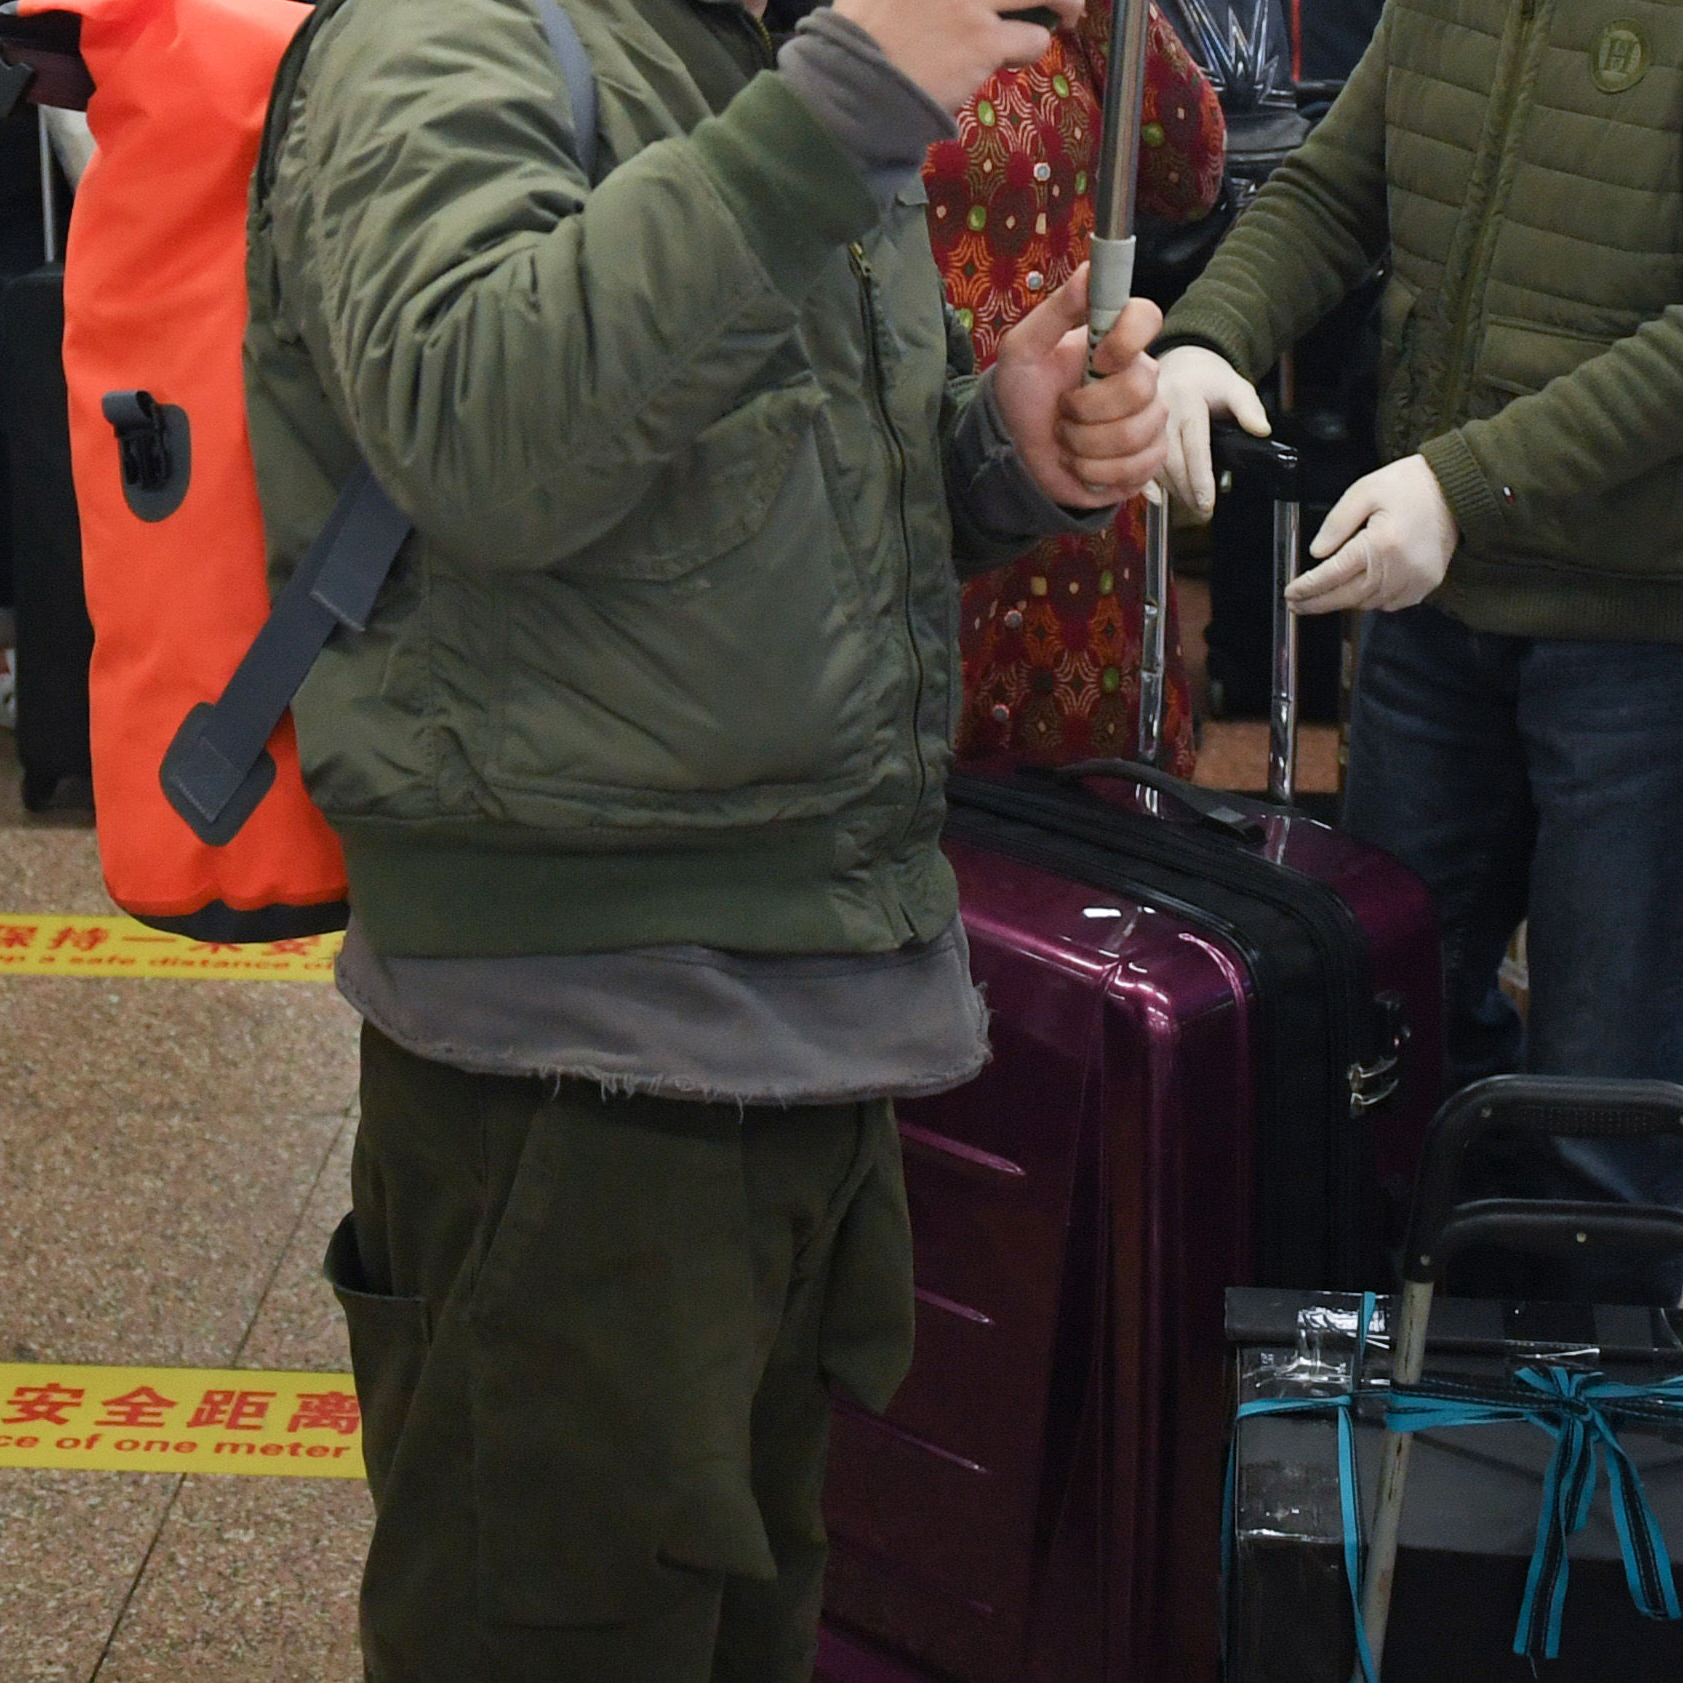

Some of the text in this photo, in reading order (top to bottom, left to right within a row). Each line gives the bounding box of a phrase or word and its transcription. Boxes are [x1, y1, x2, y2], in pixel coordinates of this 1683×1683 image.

[55, 1433, 103, 1451] of
[113, 1436, 198, 1454] one
[213, 1439, 351, 1459] meter
